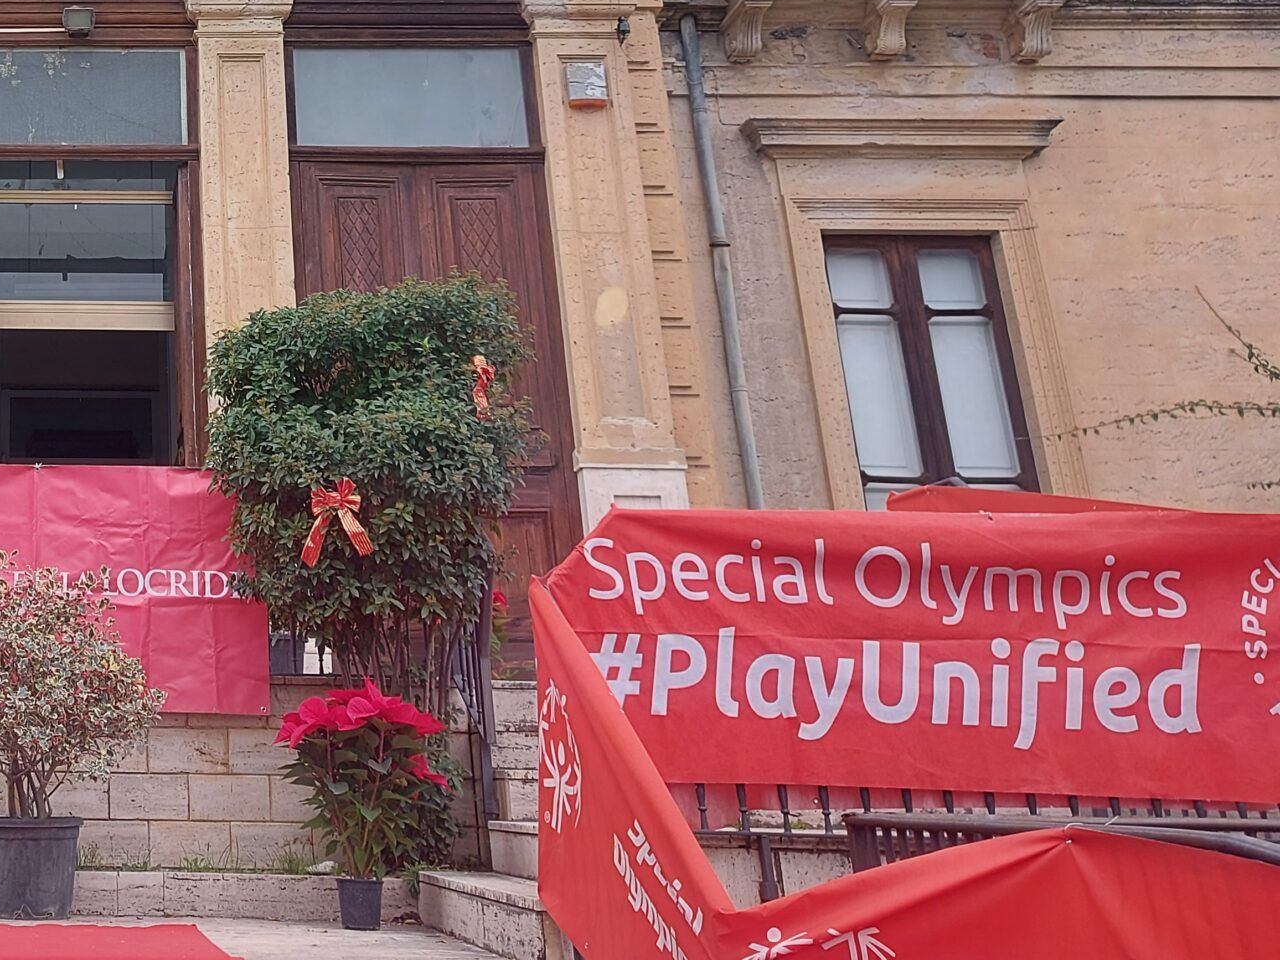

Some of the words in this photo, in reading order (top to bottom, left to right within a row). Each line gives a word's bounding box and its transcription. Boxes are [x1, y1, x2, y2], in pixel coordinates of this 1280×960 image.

[584, 537, 834, 615] Special
[854, 542, 1188, 630] Olympics
[589, 626, 1203, 751] #PlayUnified
